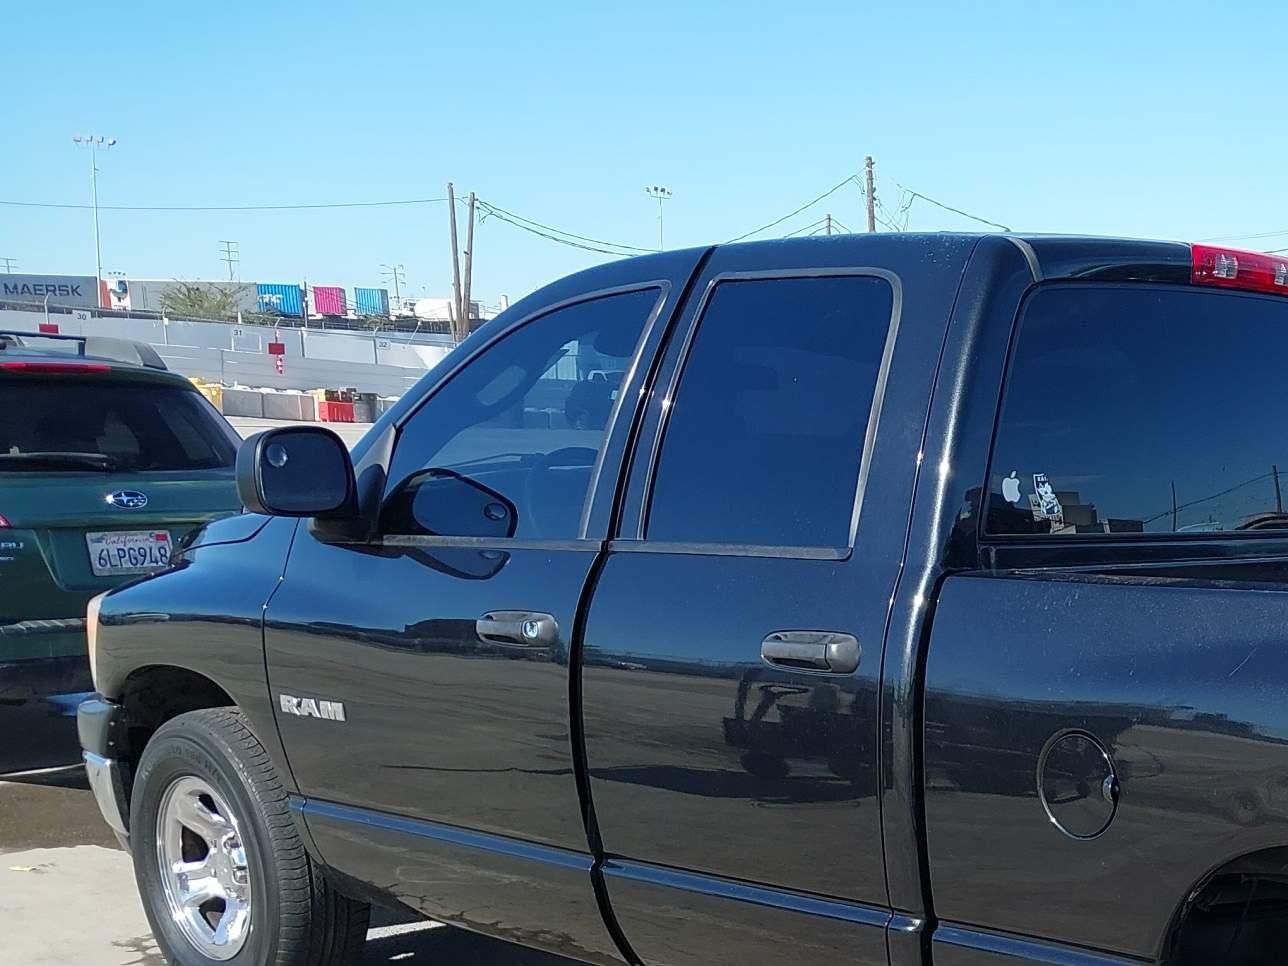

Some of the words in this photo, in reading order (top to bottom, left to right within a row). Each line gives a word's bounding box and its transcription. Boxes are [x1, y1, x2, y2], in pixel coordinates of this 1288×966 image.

[3, 282, 82, 296] MAERSK
[98, 546, 168, 569] 6LPG948
[280, 694, 346, 721] RAM
